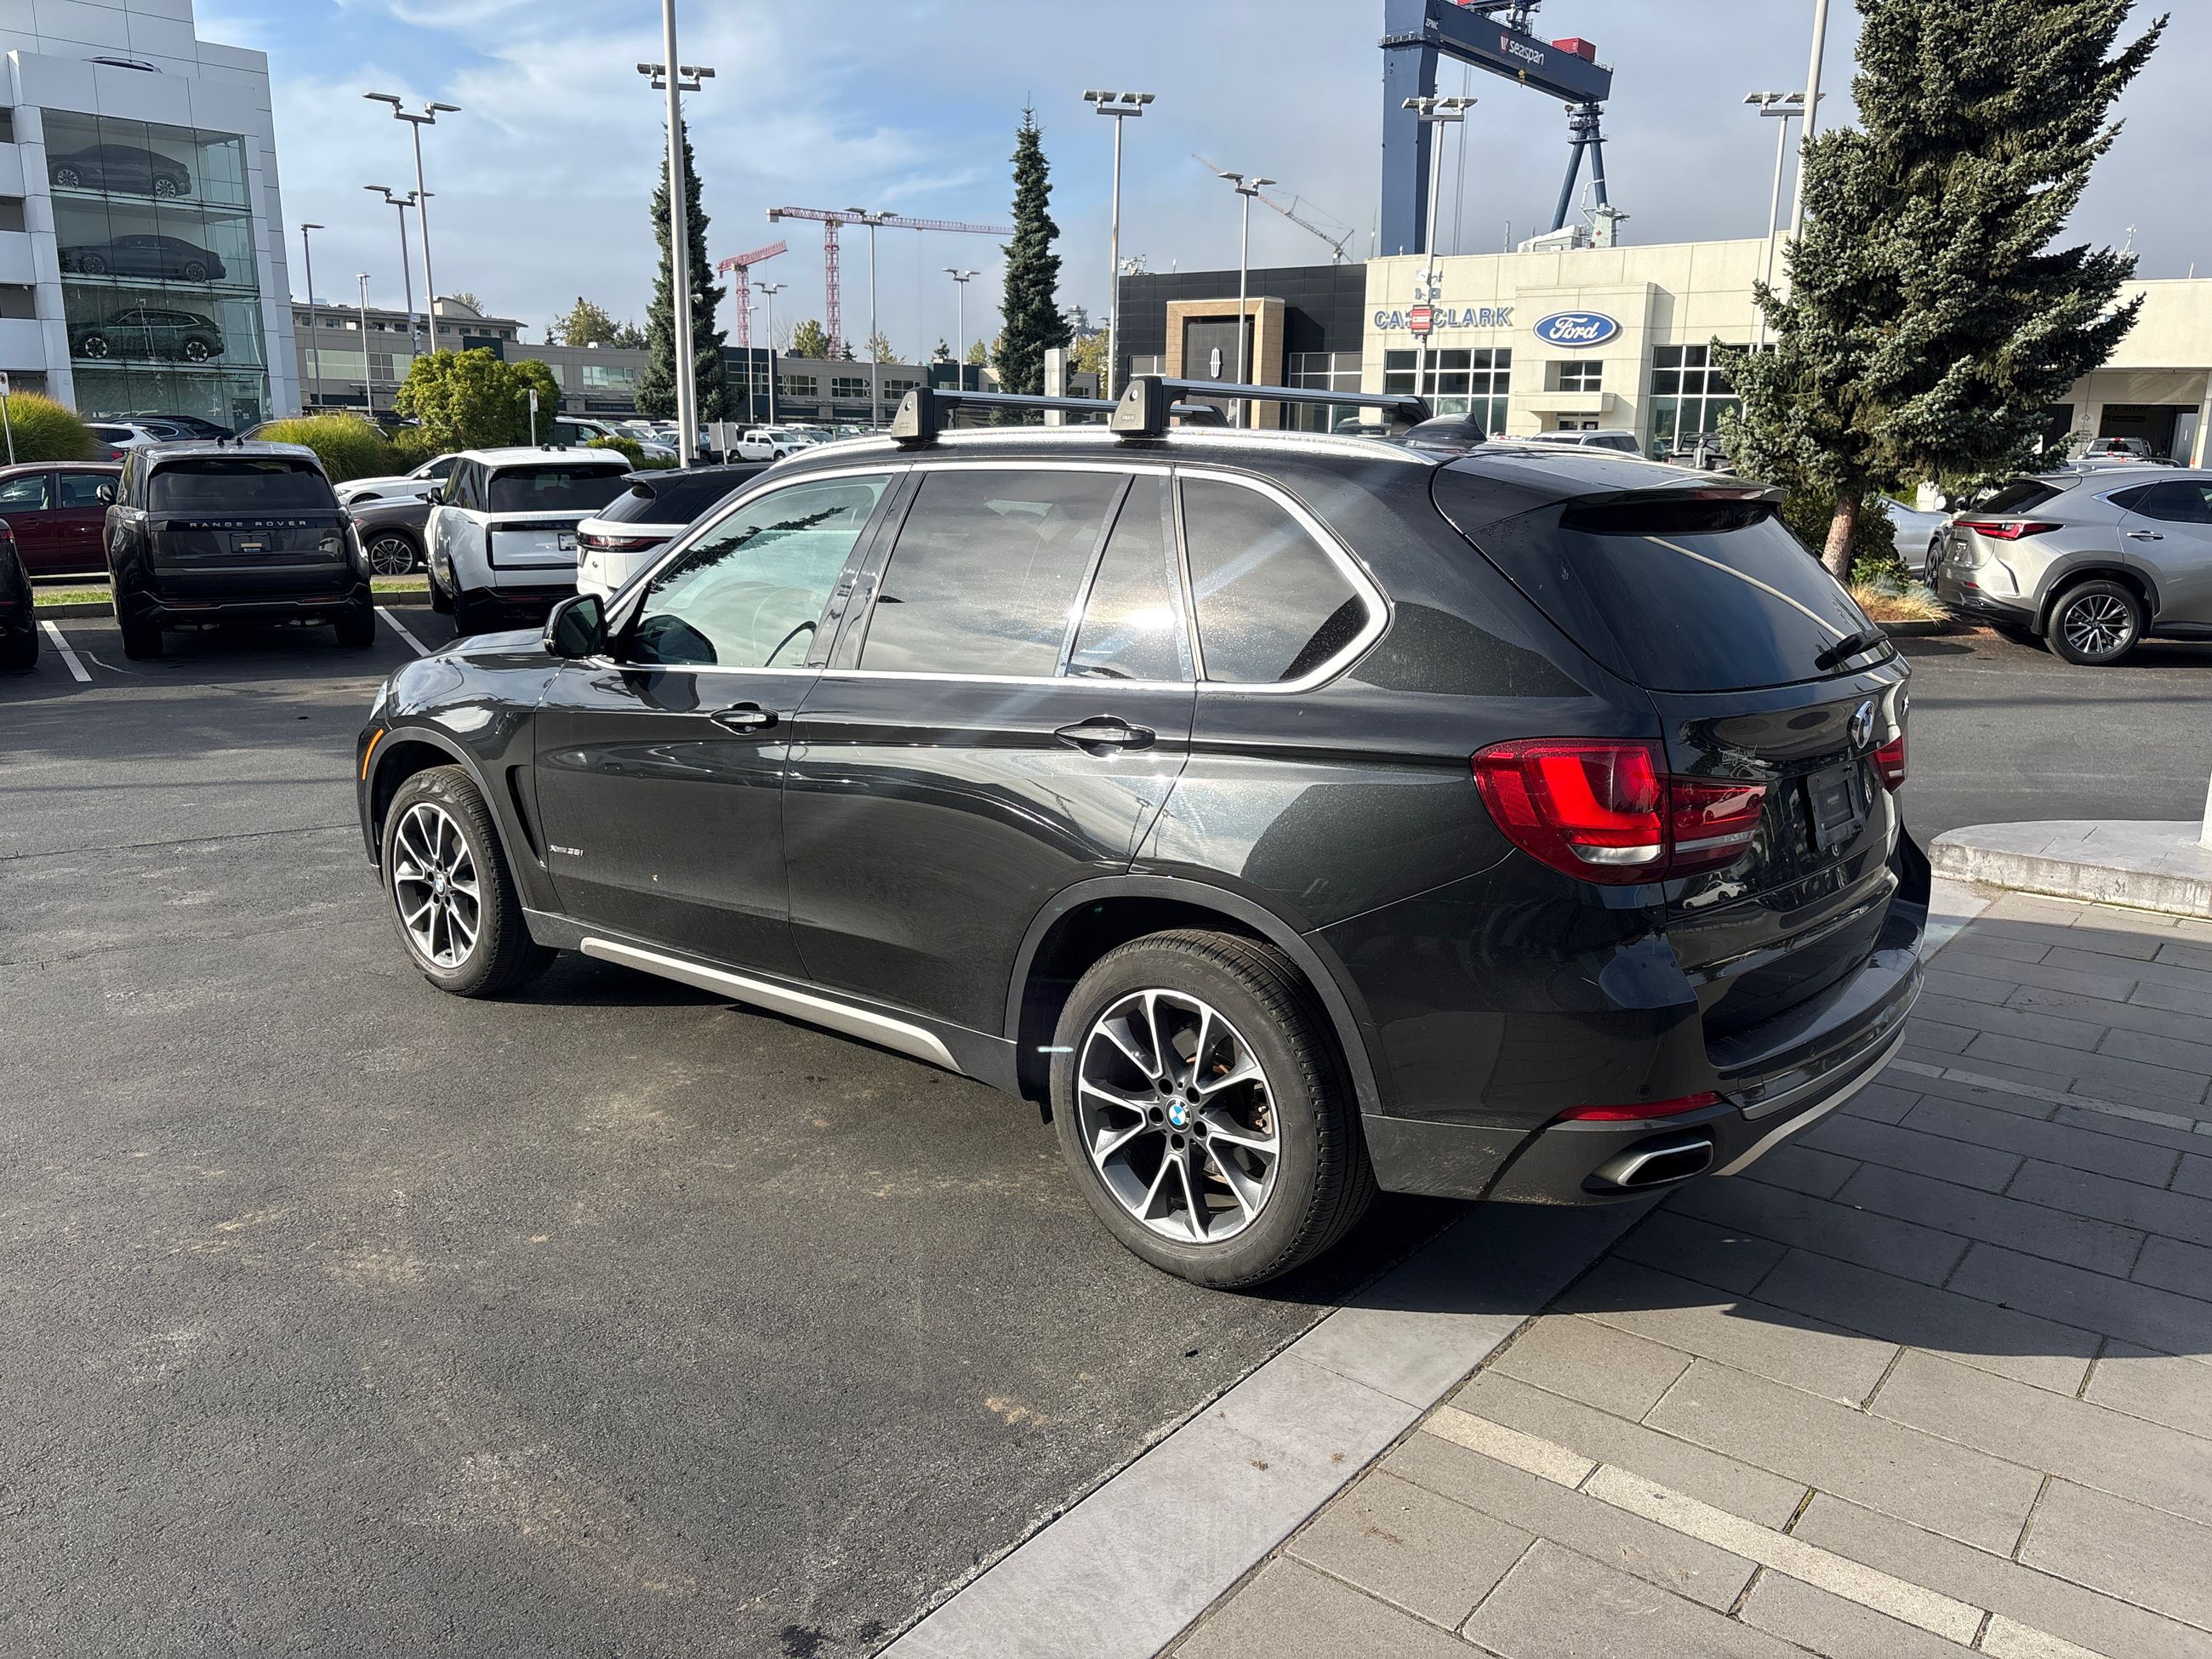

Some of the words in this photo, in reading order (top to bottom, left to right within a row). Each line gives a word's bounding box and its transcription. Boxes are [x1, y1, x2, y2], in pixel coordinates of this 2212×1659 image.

[1425, 17, 1440, 31] ZPMC
[1508, 39, 1545, 66] seaspan
[1433, 307, 1513, 328] CLARK
[1548, 316, 1600, 339] Ford
